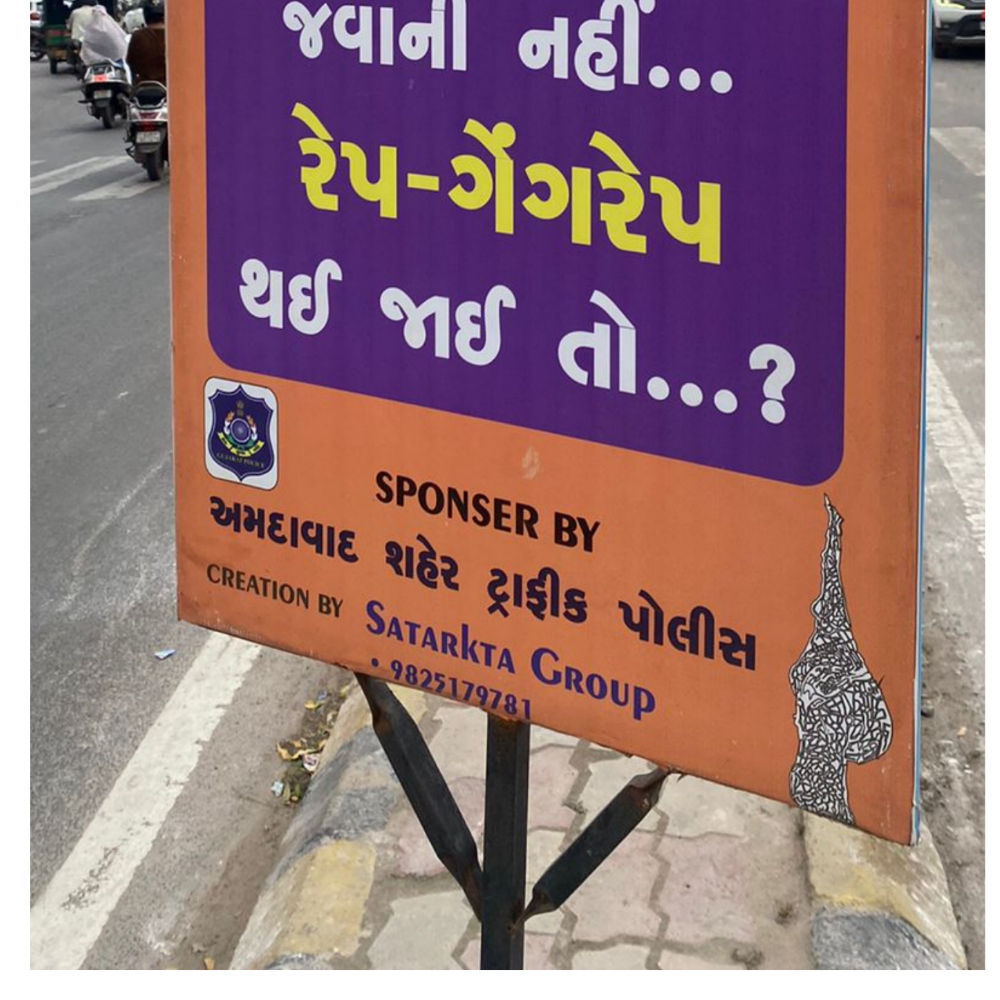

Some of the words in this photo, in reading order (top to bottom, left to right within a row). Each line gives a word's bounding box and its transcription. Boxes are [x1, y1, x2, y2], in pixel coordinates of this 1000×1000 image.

[291, 102, 721, 265] રેપ-ગેંગરેપ
[239, 258, 342, 336] થઈ
[379, 284, 516, 366] જાઈ
[375, 471, 539, 540] SPONSER
[554, 511, 600, 553] BY
[206, 563, 309, 610] CREATION
[318, 593, 343, 619] BY
[210, 495, 359, 563] અમદાવાદ
[384, 533, 460, 592] શહેર
[486, 566, 588, 624] ટ્રાફીક
[618, 588, 756, 671] પોલીસ
[390, 659, 531, 720] 9825179781
